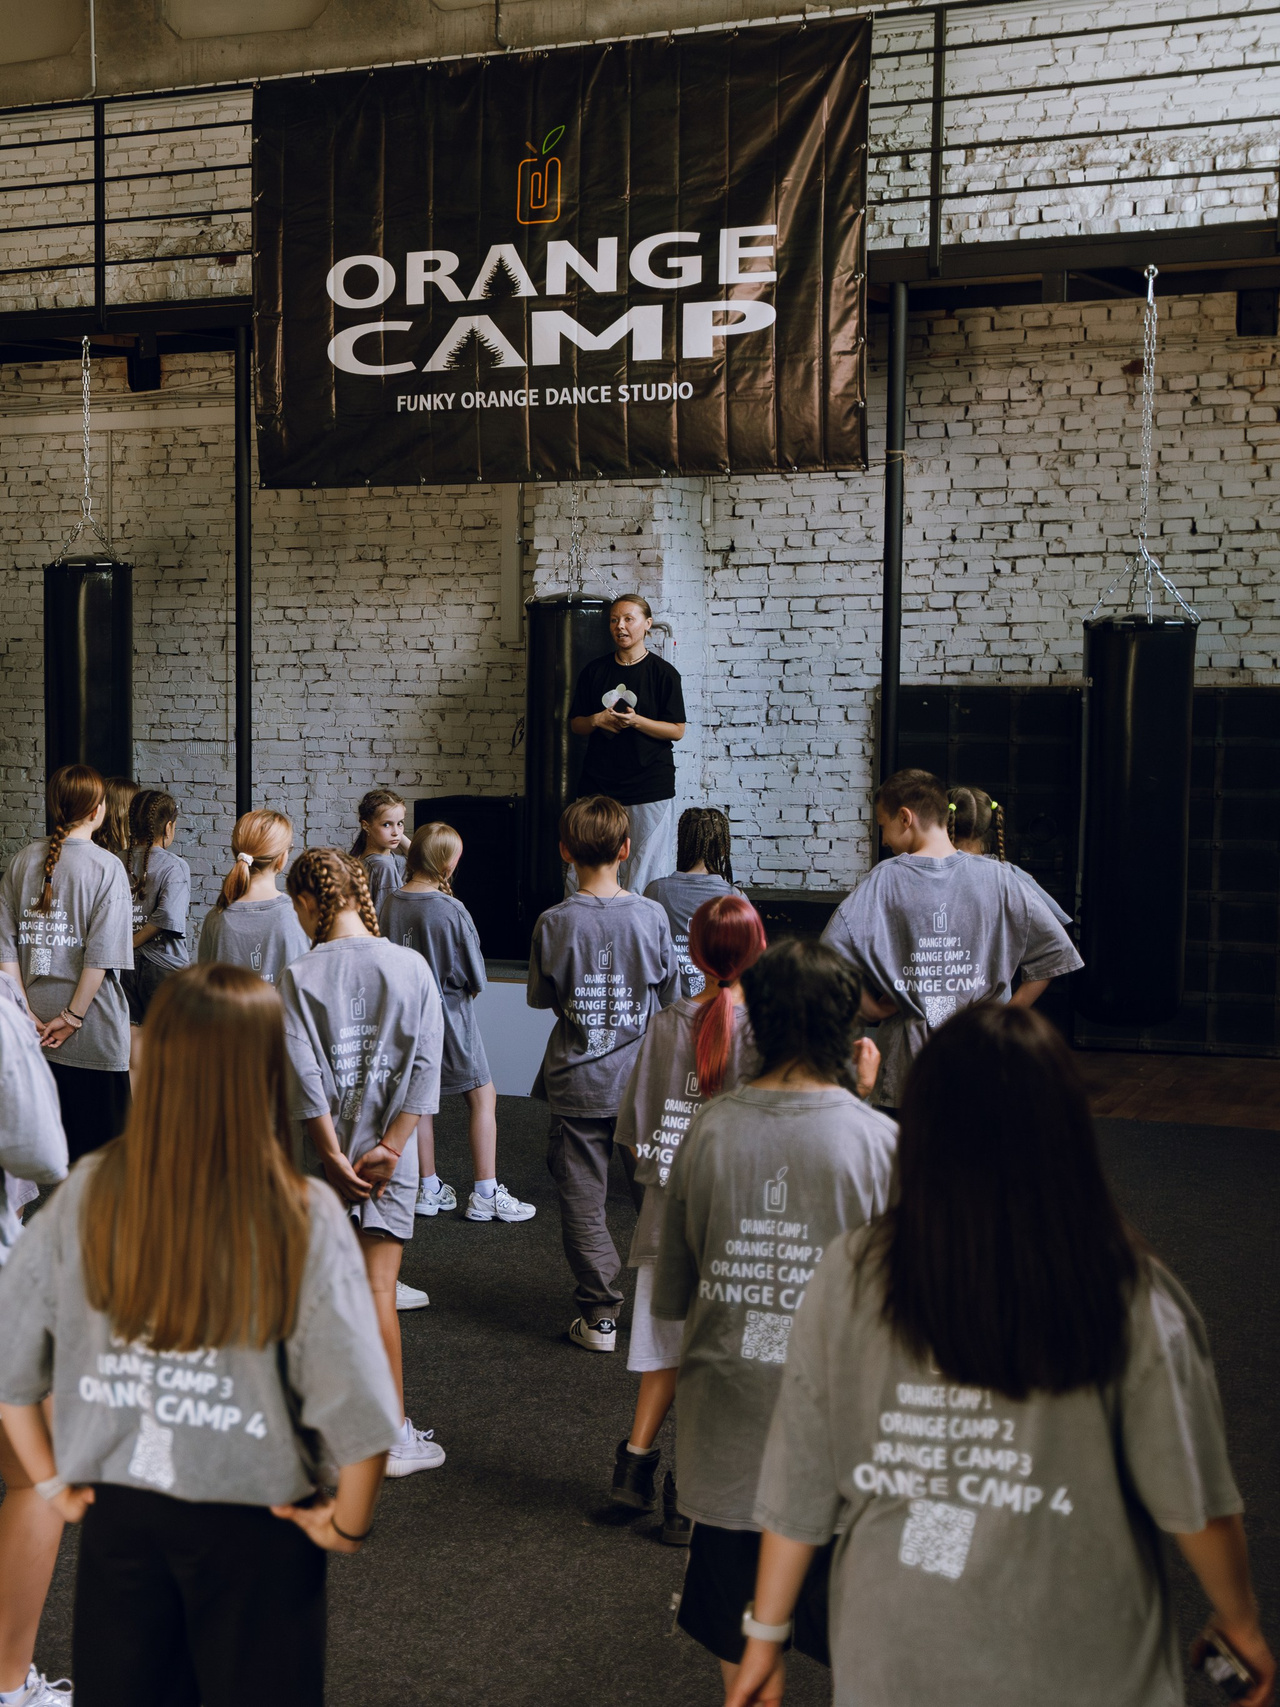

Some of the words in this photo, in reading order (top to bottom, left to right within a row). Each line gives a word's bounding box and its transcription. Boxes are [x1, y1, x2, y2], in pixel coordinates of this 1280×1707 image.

[326, 224, 778, 309] ORANGE
[327, 300, 778, 376] CAMP
[396, 393, 456, 412] FUNKY
[460, 389, 539, 409] ORANGE
[545, 385, 612, 406] DANCE
[618, 382, 694, 402] STUDIO
[62, 911, 68, 921] 2
[19, 921, 44, 931] RAGE
[45, 922, 68, 933] CAMP
[69, 924, 74, 934] 3
[18, 933, 43, 945] ANGE
[45, 934, 78, 947] CAMP
[675, 934, 689, 943] ORAN
[918, 937, 942, 948] ORANGE
[942, 936, 957, 947] CAMP
[910, 951, 942, 962] ORANGE
[943, 950, 964, 962] CAMP
[965, 950, 971, 960] 2
[679, 964, 700, 975] NGE
[902, 965, 942, 977] ORANGE
[944, 964, 973, 975] CAMP
[975, 963, 980, 974] 3
[583, 973, 606, 984] ORANGE
[606, 973, 621, 984] CAMP
[945, 977, 977, 992] CAM
[978, 974, 986, 987] 4
[574, 986, 606, 997] ORANGE
[607, 987, 626, 998] CAMP
[626, 987, 633, 997] 2
[568, 999, 607, 1011] ORANGE
[608, 1000, 633, 1011] CAMP
[634, 1001, 641, 1011] 3
[563, 1008, 607, 1026] RANGE
[340, 1025, 360, 1040] ORANGE
[331, 1040, 361, 1055] ORANGE
[331, 1055, 362, 1071] ANGE
[381, 1055, 388, 1066] 3
[335, 1070, 363, 1088] NGE
[364, 1069, 391, 1085] AMP
[664, 1098, 692, 1114] ORANGE
[740, 1218, 776, 1236] ORANGE
[777, 1221, 801, 1239] CAMP
[801, 1224, 809, 1240] 1
[725, 1239, 775, 1258] ORANGE
[776, 1243, 813, 1262] CAMP
[814, 1246, 824, 1263] 2
[711, 1259, 775, 1280] ORANGE
[777, 1265, 815, 1284] CAM
[699, 1279, 775, 1307] RANGE
[156, 1364, 219, 1395] CAMP
[219, 1374, 234, 1400] 3
[155, 1394, 243, 1433] CAMP
[245, 1411, 268, 1441] 4
[879, 1411, 948, 1439] ORANGE
[948, 1417, 1000, 1441] CAMP
[1001, 1419, 1016, 1443] 2
[953, 1446, 1019, 1473] CAMP
[1019, 1451, 1033, 1478] 3
[852, 1462, 949, 1499] OANGE
[956, 1474, 1044, 1514] CAMP
[1050, 1486, 1074, 1517] 4
